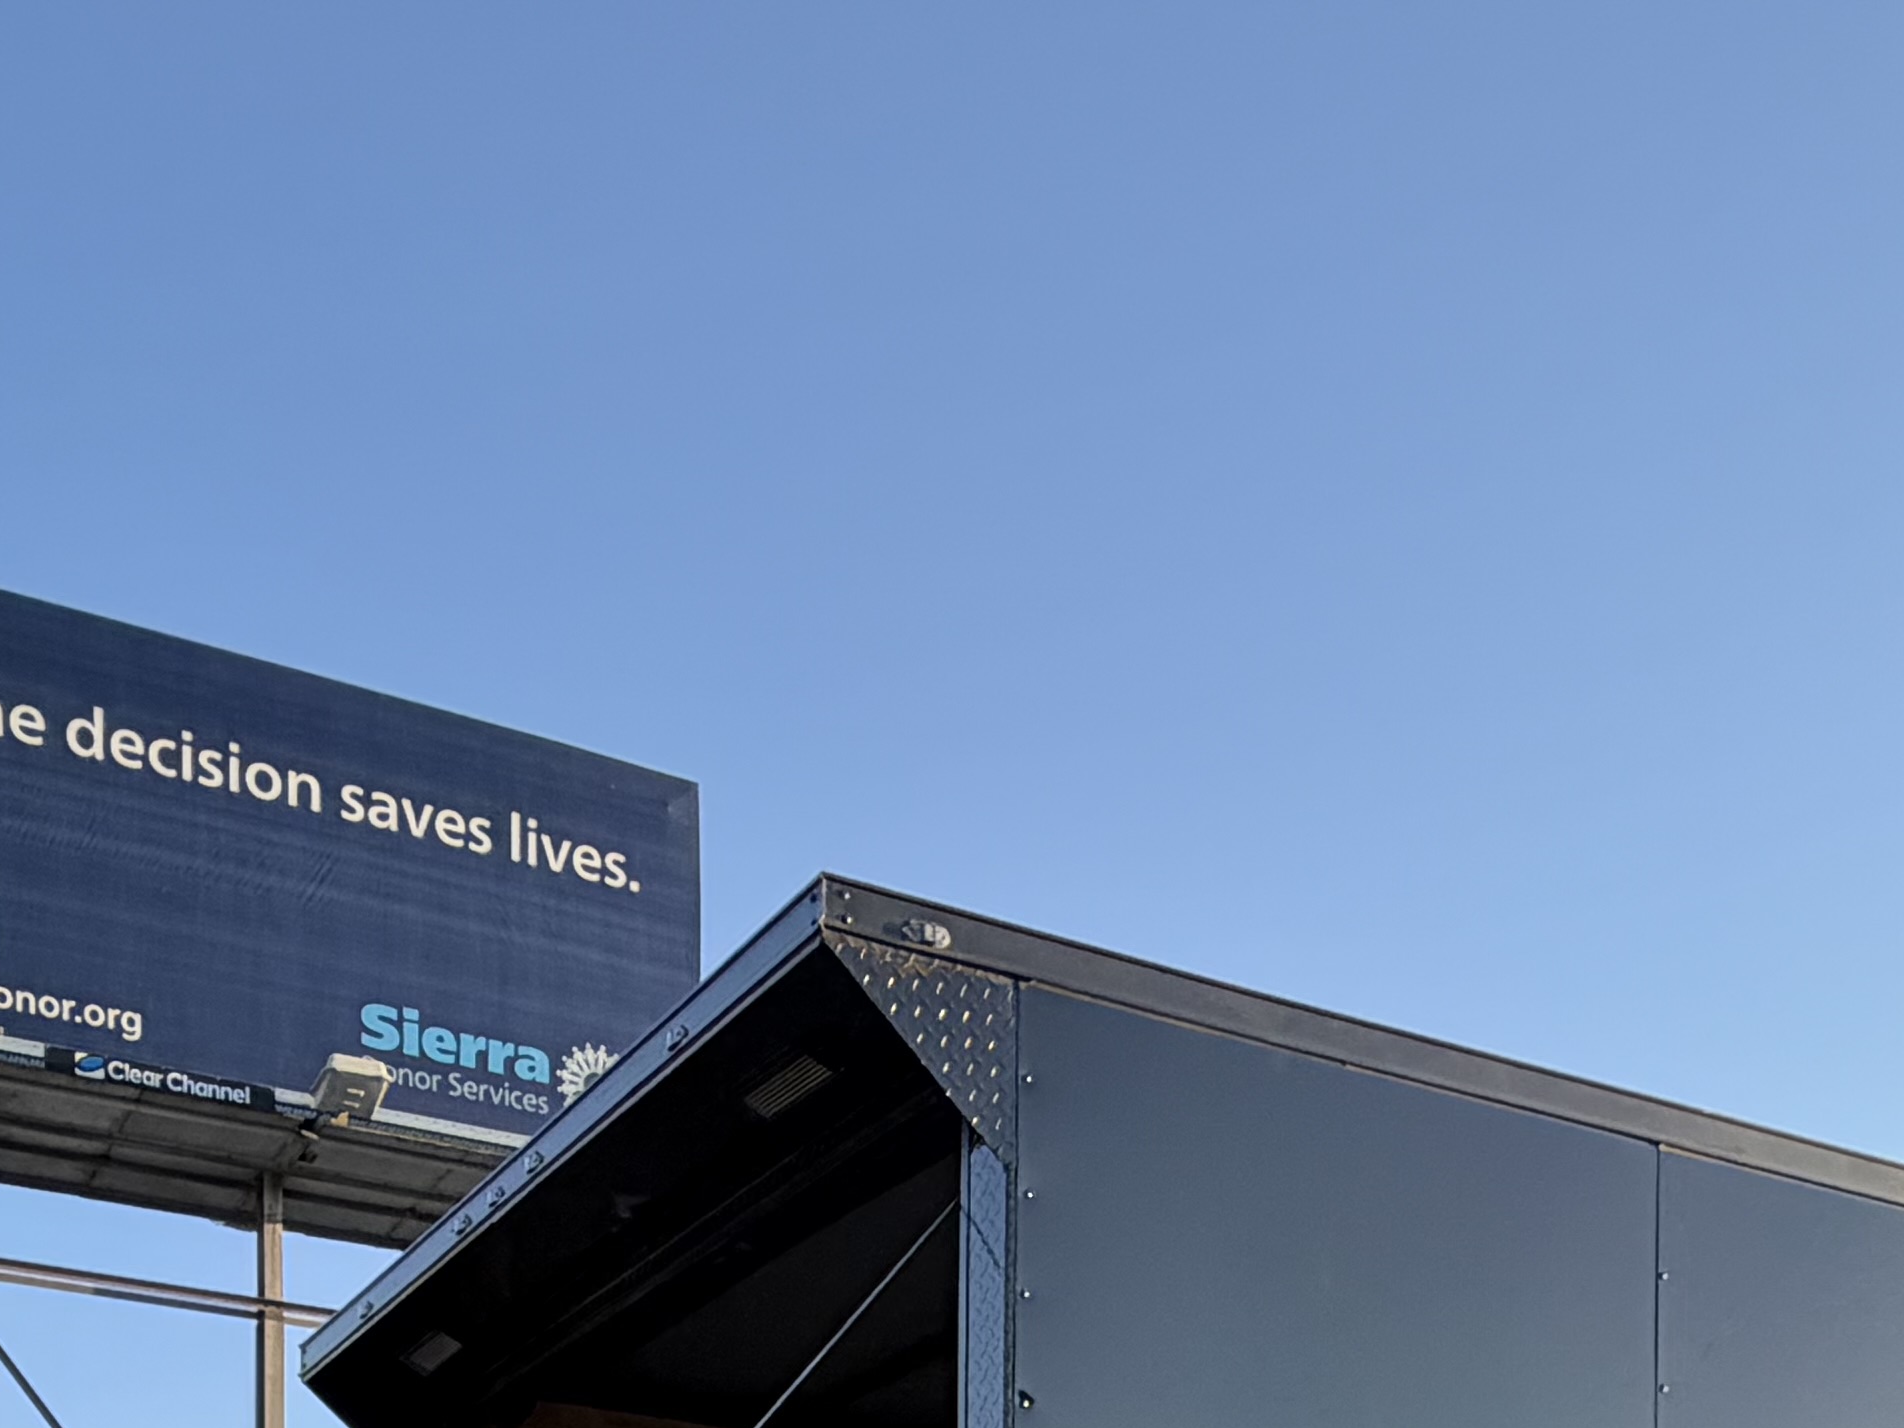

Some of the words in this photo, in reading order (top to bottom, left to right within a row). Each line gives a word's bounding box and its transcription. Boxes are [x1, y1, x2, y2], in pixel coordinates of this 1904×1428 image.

[66, 705, 322, 813] decision
[340, 784, 493, 855] saves
[511, 811, 640, 893] lives.
[361, 1003, 550, 1084] Sierra
[107, 1060, 164, 1088] Clear
[167, 1072, 251, 1104] Channel
[386, 1064, 442, 1092] onor
[448, 1072, 550, 1114] Services
